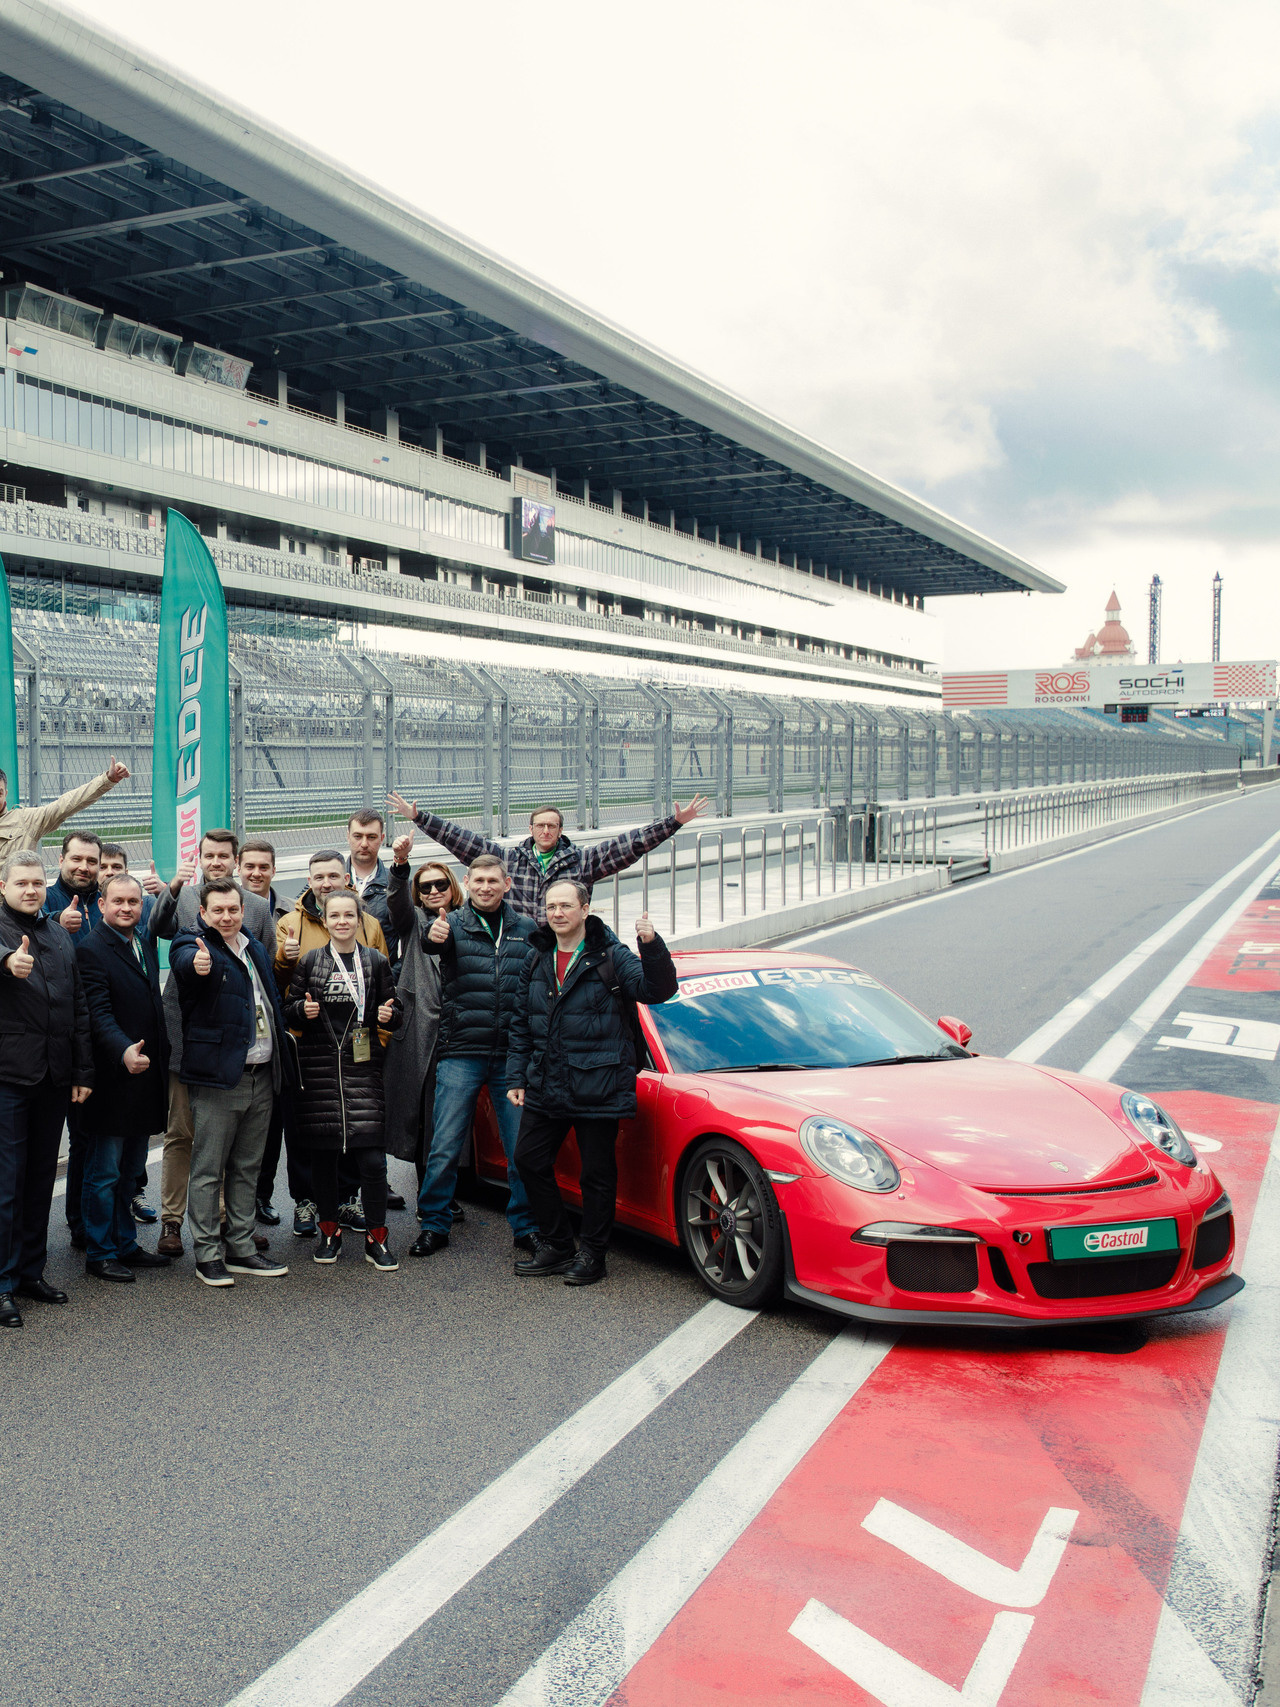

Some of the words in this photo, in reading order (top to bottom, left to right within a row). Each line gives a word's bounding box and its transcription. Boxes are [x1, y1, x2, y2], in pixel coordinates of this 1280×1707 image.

[1035, 671, 1090, 695] ROS
[1119, 677, 1184, 689] SOCHI
[1035, 695, 1090, 704] ROSGONKI
[1119, 689, 1184, 697] AUTODROM
[679, 974, 751, 997] Castrol
[759, 968, 883, 990] EDGE
[1100, 1230, 1144, 1248] Castrol
